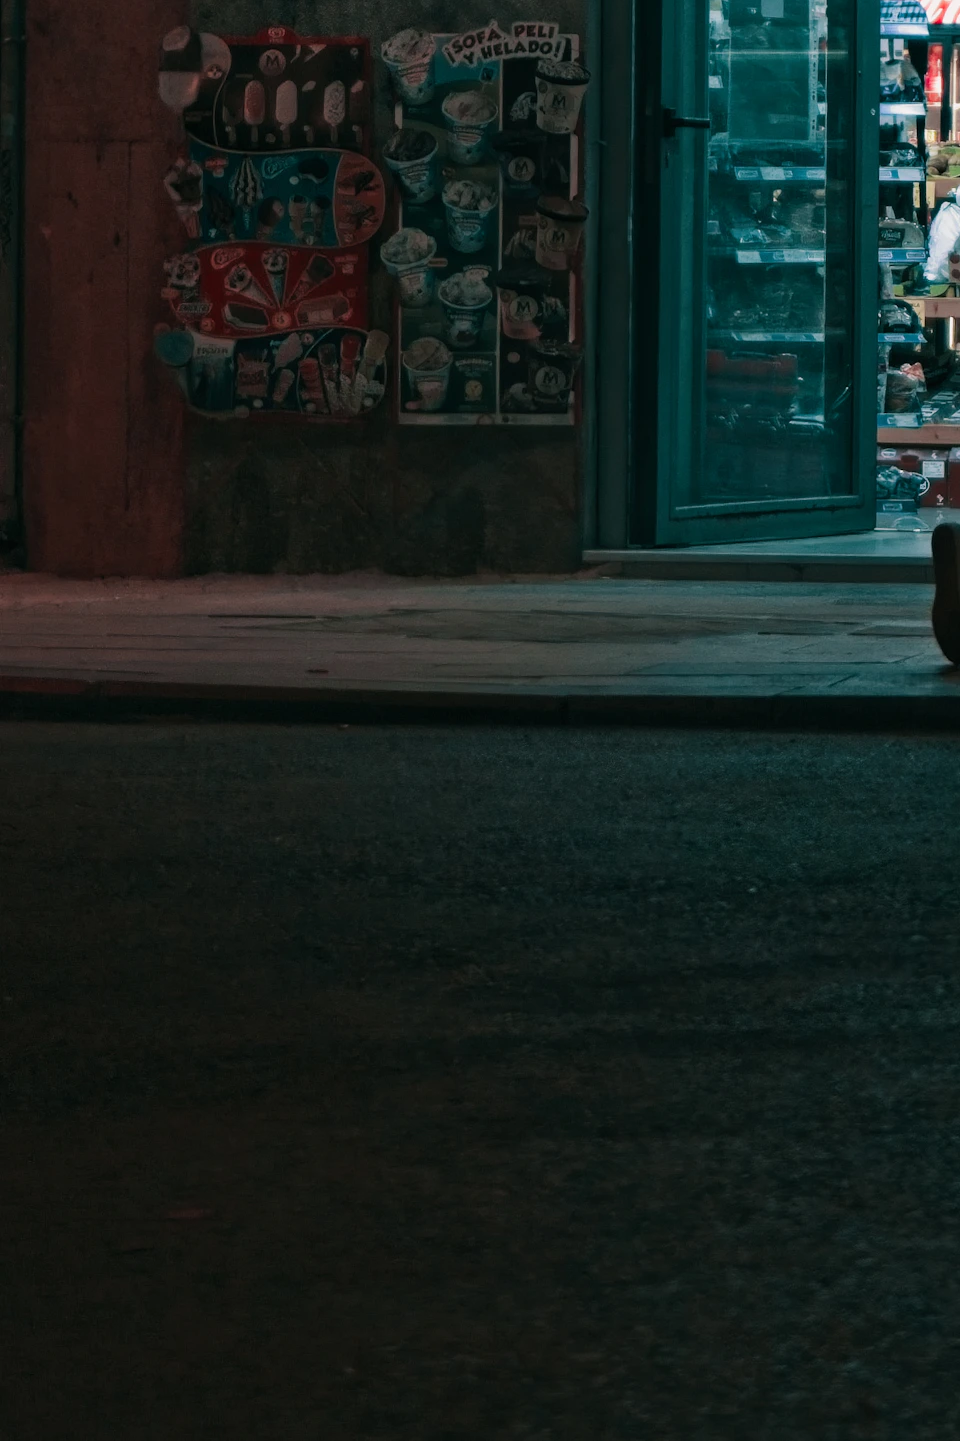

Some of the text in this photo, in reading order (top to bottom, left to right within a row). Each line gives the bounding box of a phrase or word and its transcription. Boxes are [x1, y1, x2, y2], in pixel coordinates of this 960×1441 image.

[513, 24, 556, 39] PELI
[463, 39, 562, 64] Y HELADO!
